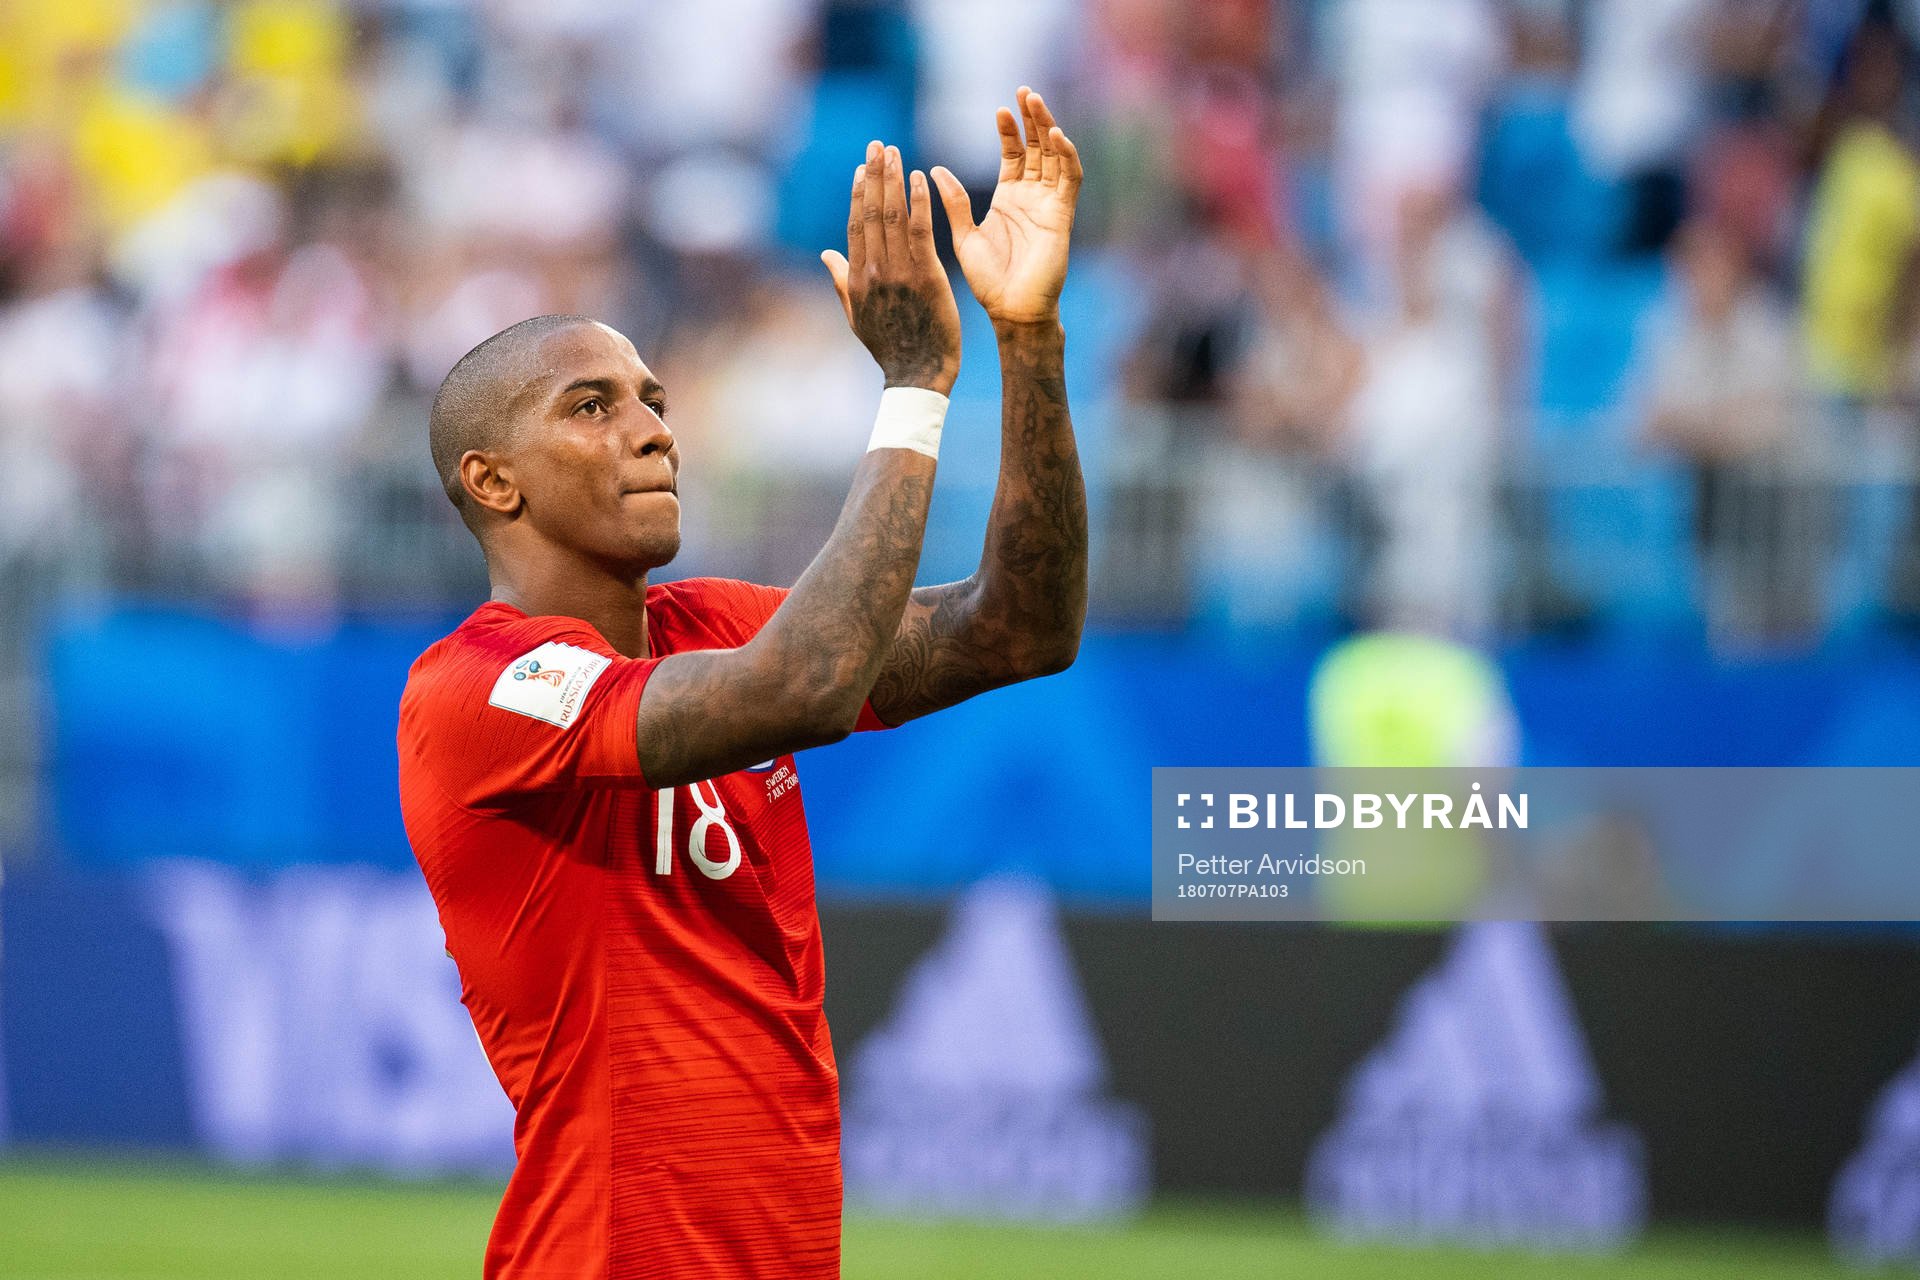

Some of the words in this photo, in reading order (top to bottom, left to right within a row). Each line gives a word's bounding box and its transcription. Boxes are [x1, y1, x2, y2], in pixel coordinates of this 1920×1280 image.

[560, 680, 584, 722] RUSSIA
[765, 765, 790, 790] SWEDEN
[766, 792, 772, 803] 7
[772, 782, 786, 800] JULY
[784, 773, 799, 790] 2018
[655, 778, 742, 880] 18
